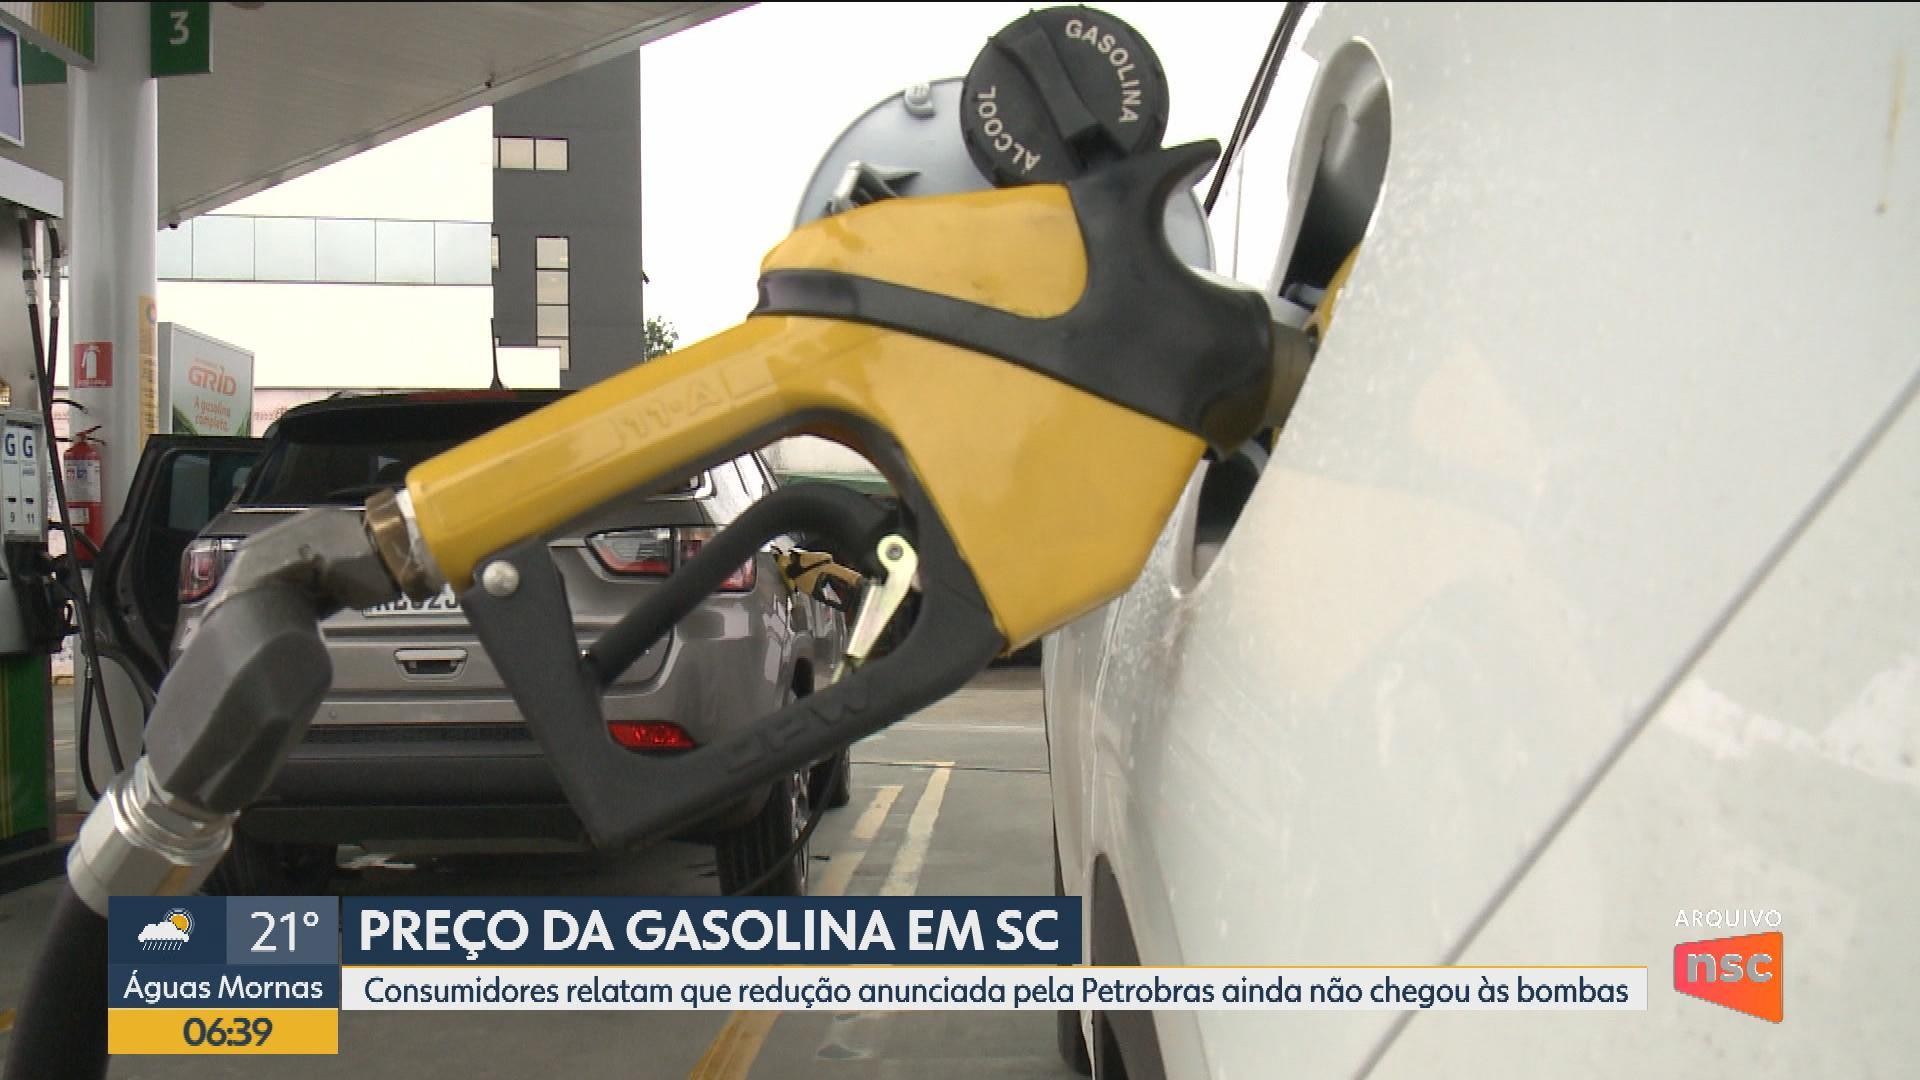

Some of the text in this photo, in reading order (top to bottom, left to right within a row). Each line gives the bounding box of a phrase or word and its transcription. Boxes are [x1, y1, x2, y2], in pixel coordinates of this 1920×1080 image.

[169, 11, 189, 45] 3
[1065, 19, 1143, 123] GASOLINA
[188, 363, 237, 397] GRID
[5, 433, 16, 457] G
[23, 435, 33, 458] G
